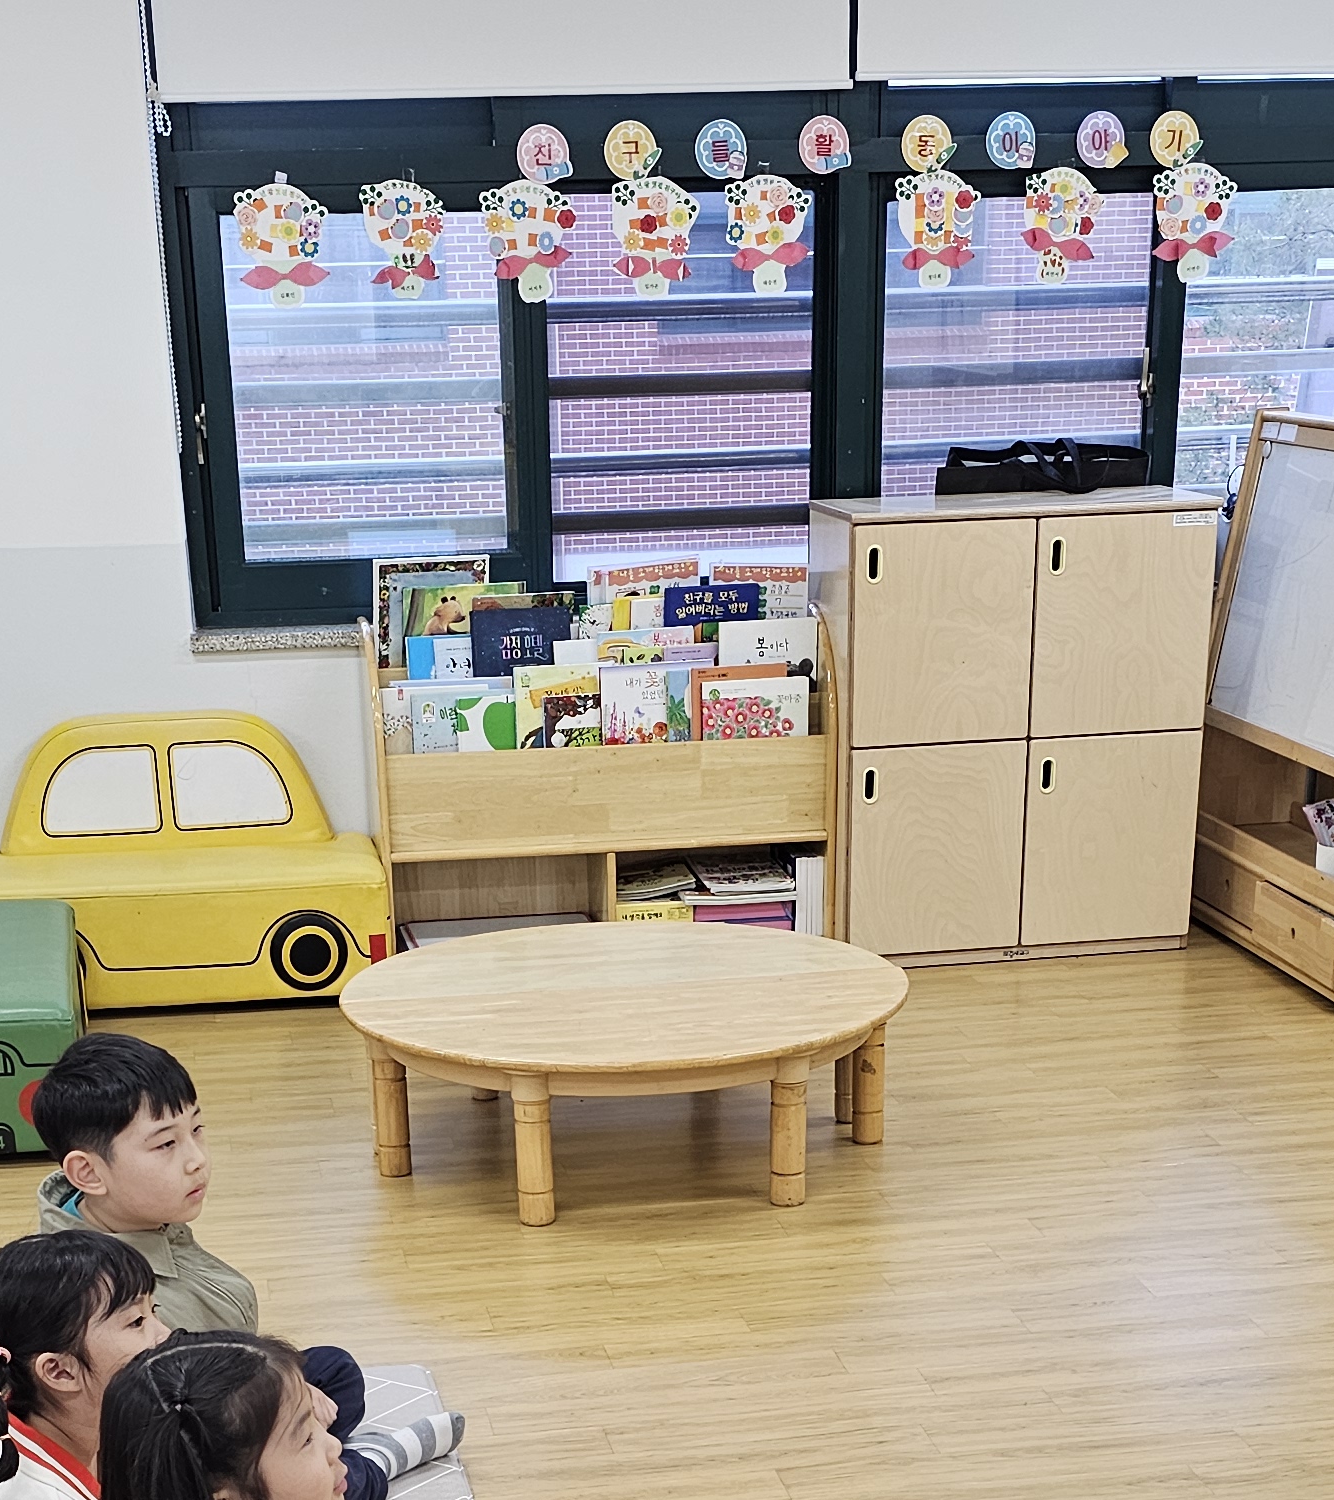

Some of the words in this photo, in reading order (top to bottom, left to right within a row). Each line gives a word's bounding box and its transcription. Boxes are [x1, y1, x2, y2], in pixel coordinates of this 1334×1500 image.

[684, 592, 713, 604] 친구를
[718, 590, 739, 601] 모두
[728, 602, 749, 614] 방법
[499, 635, 521, 660] 감정
[523, 634, 549, 661] 호텔
[625, 677, 642, 688] 내가
